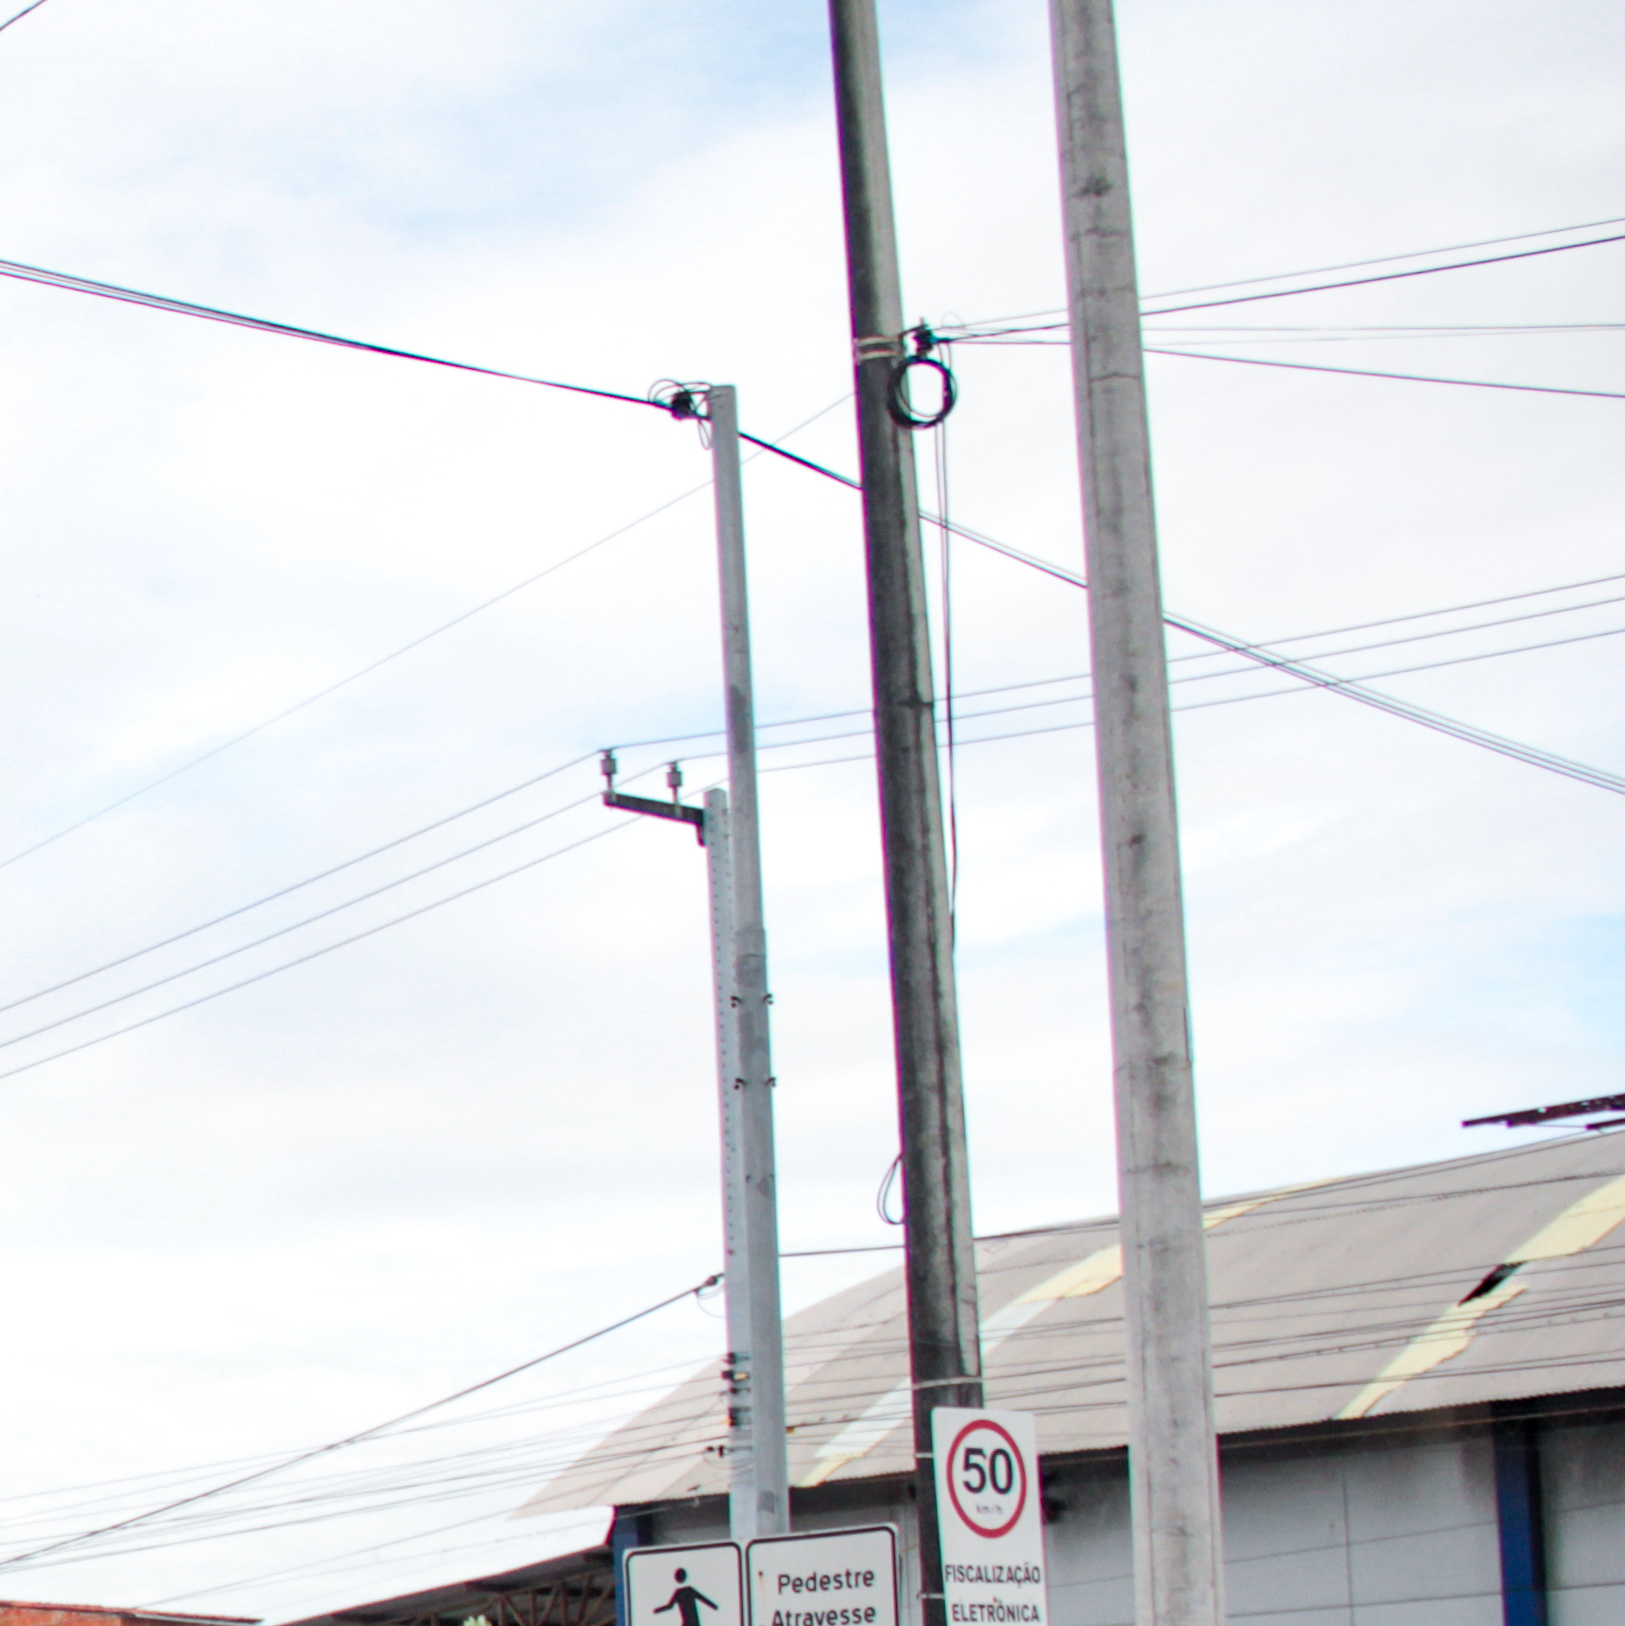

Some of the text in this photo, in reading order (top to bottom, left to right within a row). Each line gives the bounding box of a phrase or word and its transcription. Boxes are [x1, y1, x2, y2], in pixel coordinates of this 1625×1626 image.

[962, 1447, 1013, 1495] 50
[777, 1568, 875, 1595] Pedestre
[944, 1562, 1041, 1588] FISCALIZAÇÃO
[952, 1600, 1040, 1623] ELETRÔNICA
